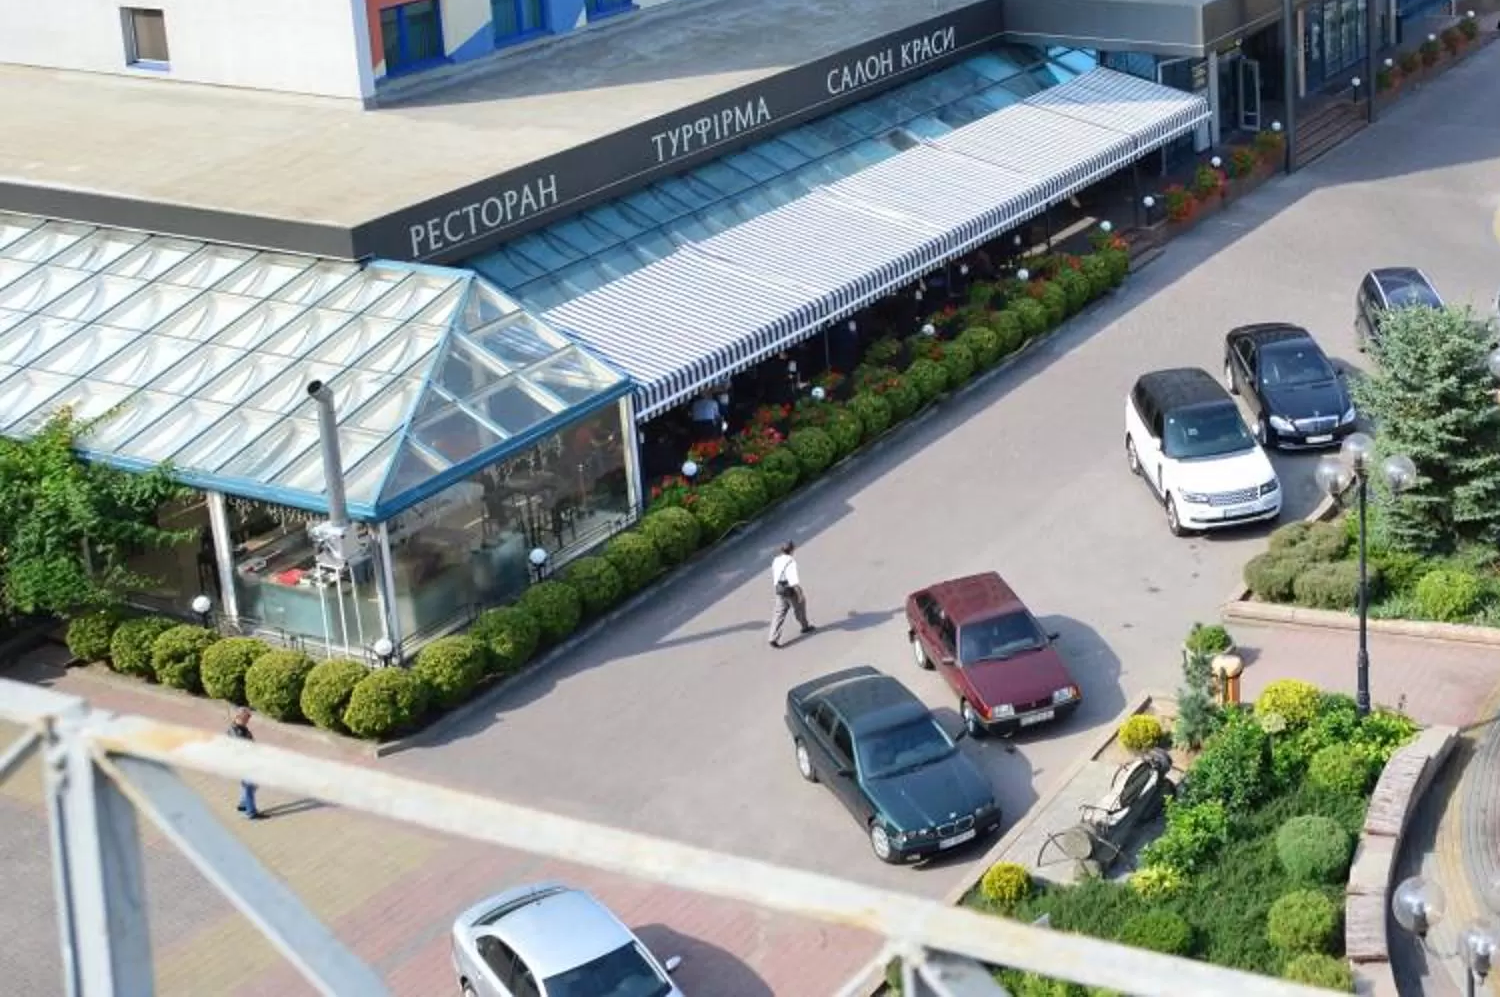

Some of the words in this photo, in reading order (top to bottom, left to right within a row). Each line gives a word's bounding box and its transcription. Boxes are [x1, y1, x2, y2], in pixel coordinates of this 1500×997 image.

[827, 48, 893, 94] САЛОН
[901, 26, 955, 68] КРАСИ
[651, 96, 772, 162] ТУРФІРМА
[409, 175, 558, 257] РЕСТОРАН
